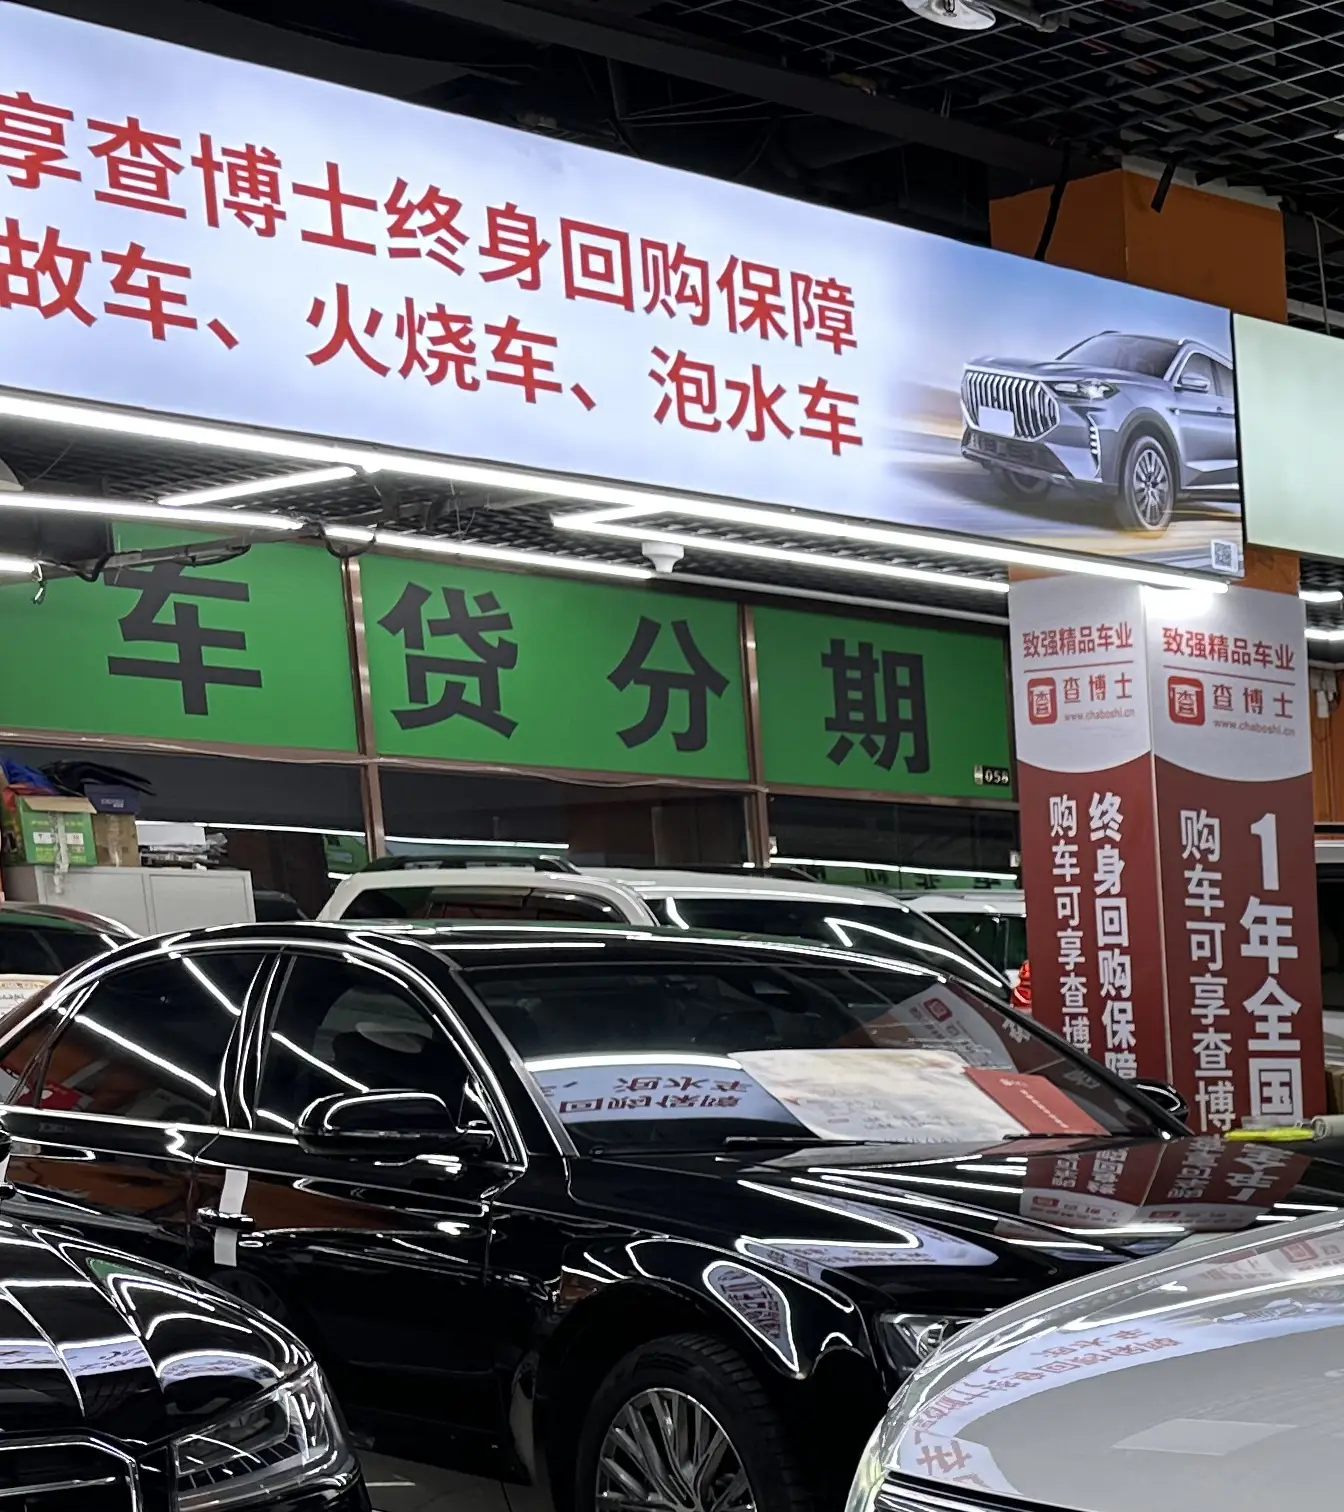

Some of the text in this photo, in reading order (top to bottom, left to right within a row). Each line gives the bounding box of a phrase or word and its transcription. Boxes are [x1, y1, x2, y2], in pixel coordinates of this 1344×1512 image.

[0, 91, 858, 356] 享查博士终身回购保障
[1022, 621, 1133, 658] 致强精品车业
[1162, 627, 1296, 671] 致强精品车业
[105, 560, 935, 776] 车贷分期
[1063, 672, 1133, 704] 查博士
[1212, 683, 1294, 719] 查博士
[1240, 812, 1303, 1123] 1年全国
